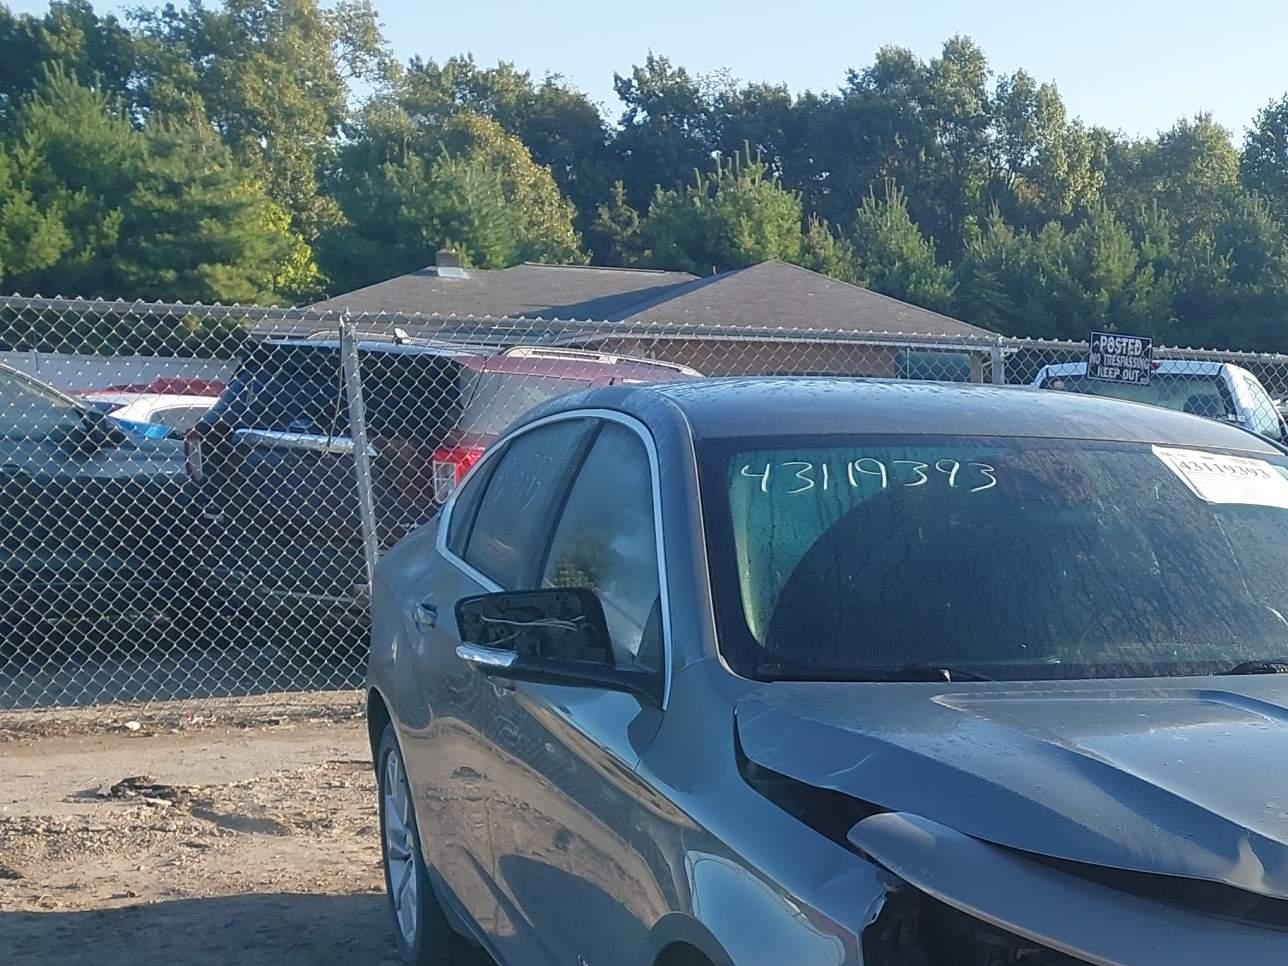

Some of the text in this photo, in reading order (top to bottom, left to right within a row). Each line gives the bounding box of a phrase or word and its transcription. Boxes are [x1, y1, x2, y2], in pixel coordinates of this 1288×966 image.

[1100, 336, 1143, 356] POSTED
[1090, 352, 1149, 369] NO TRESPASSING
[1097, 366, 1140, 383] KEEP OUT
[740, 457, 998, 494] 43119393
[1179, 460, 1272, 479] 43119393
